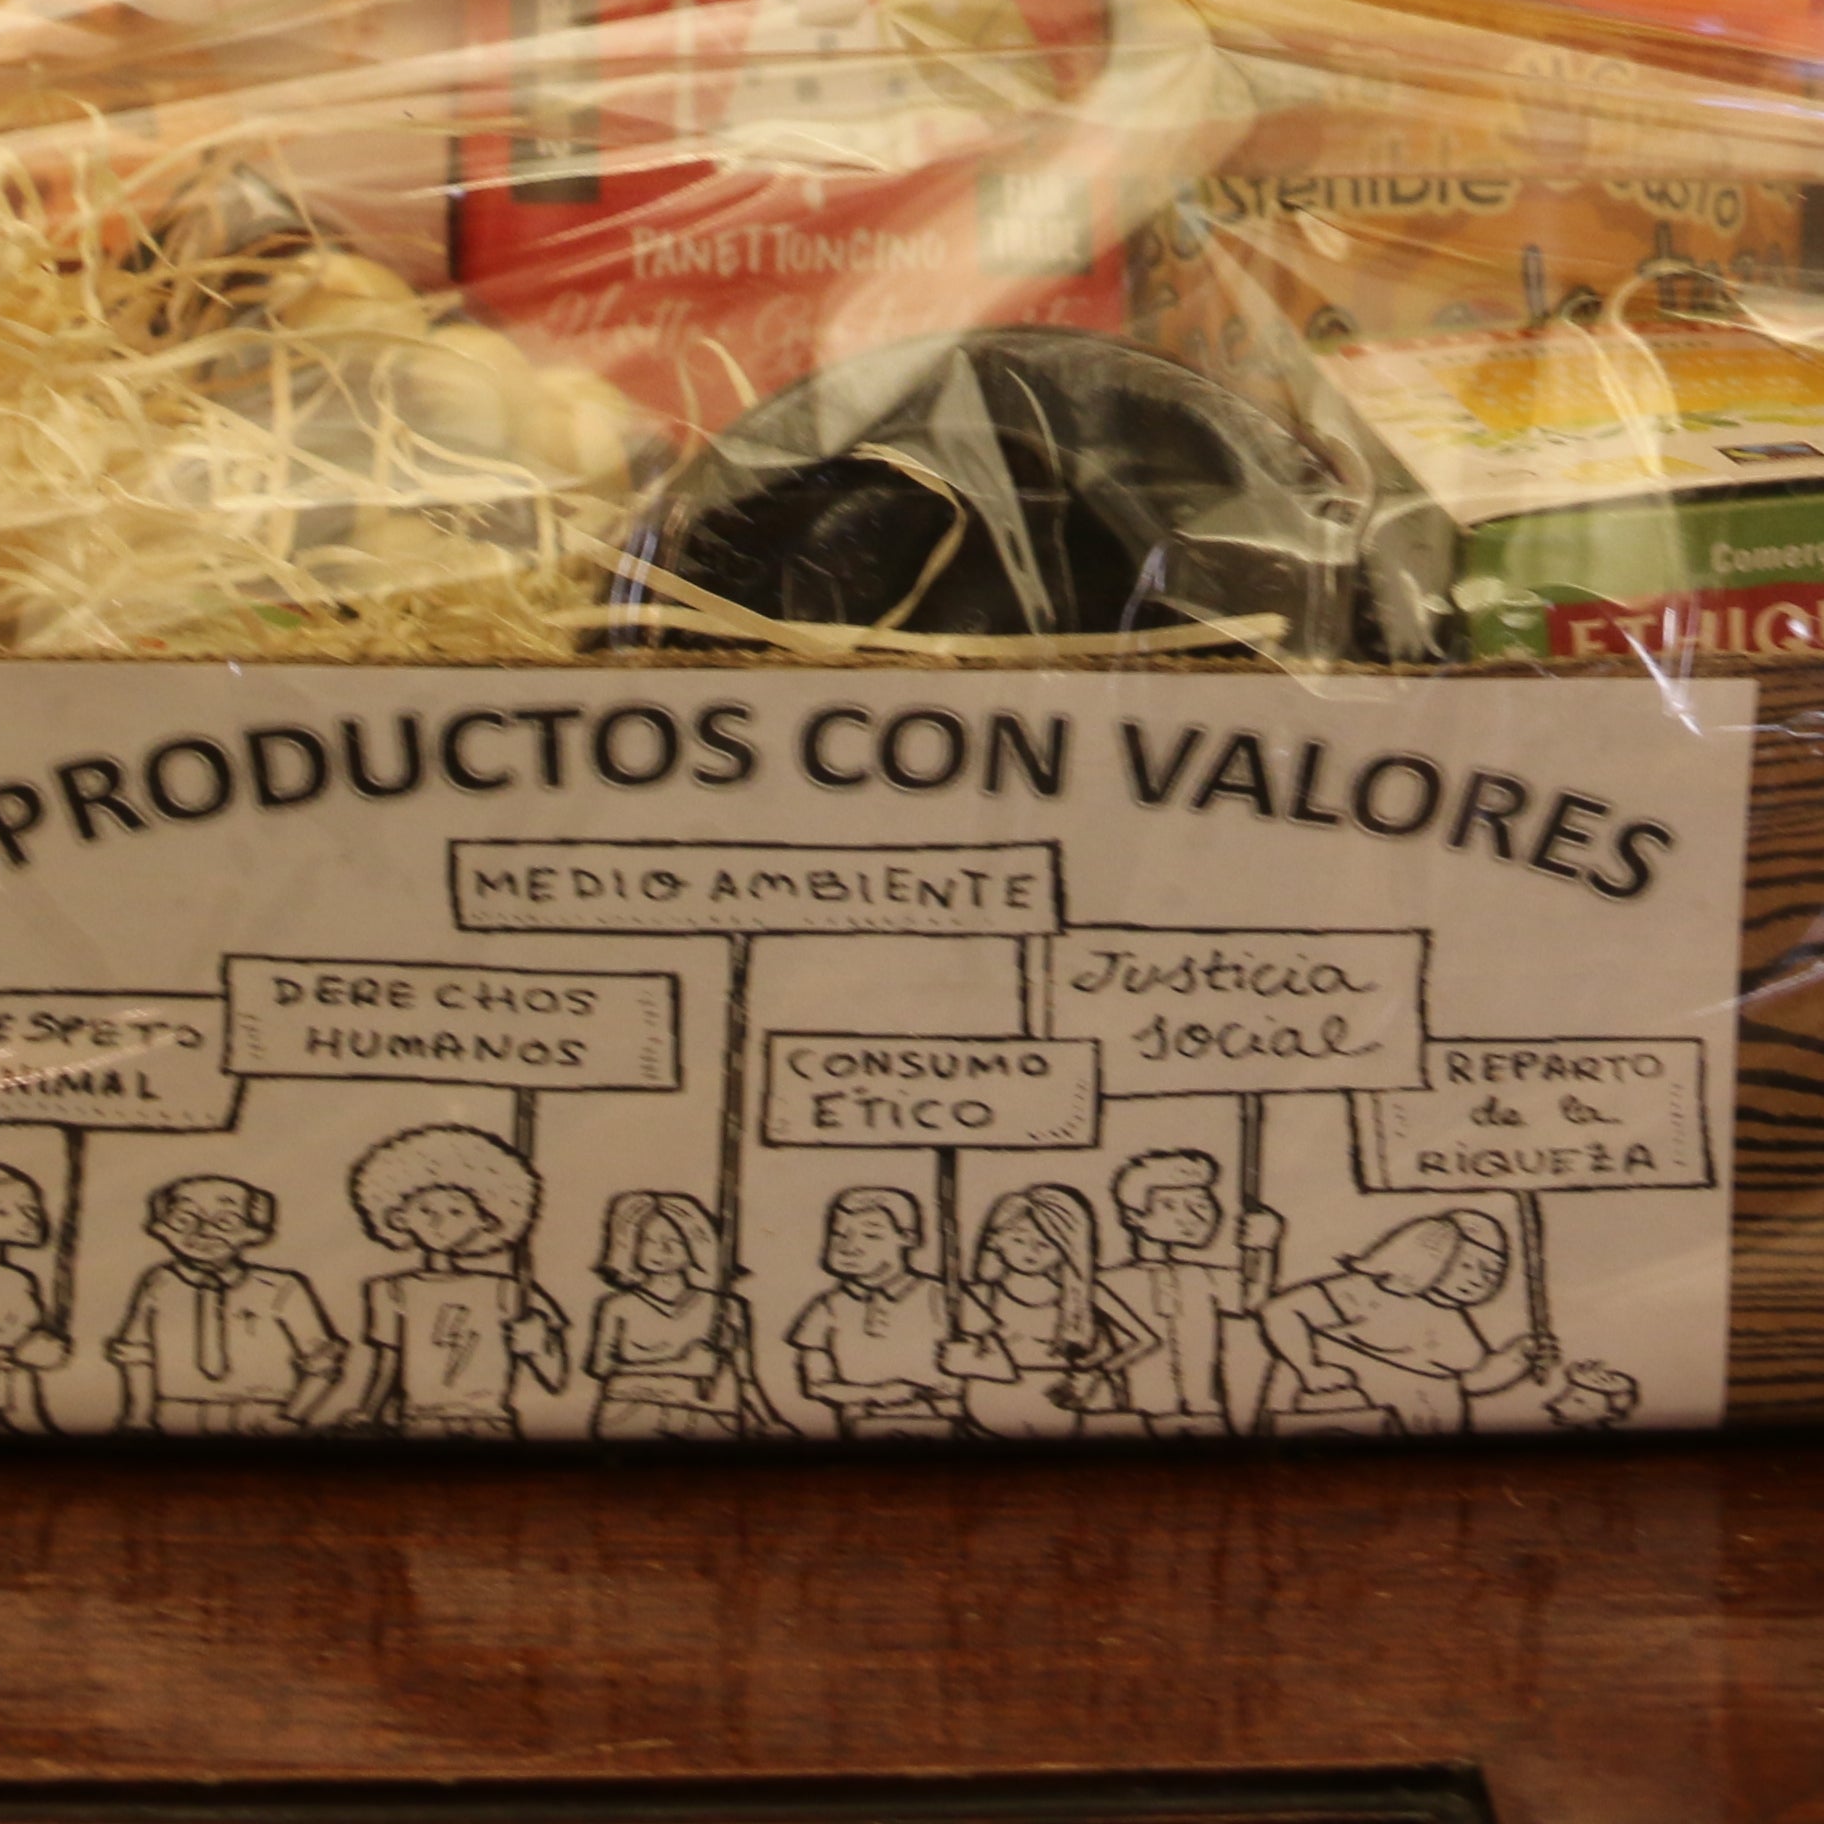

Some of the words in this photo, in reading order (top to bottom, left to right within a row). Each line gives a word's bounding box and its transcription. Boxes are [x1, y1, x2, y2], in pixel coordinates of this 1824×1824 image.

[800, 704, 1069, 798] CON
[1119, 718, 1674, 903] VALORES
[473, 864, 684, 904] MEDIO
[708, 866, 1036, 912] AMBIENTE
[1071, 948, 1378, 998] Justicia
[272, 975, 600, 1018] DERECHOS
[306, 1026, 590, 1069] HUMANOS
[1130, 1012, 1384, 1062] social
[787, 1047, 1050, 1081] CONSUMO
[1444, 1049, 1665, 1084] REPARTO
[1417, 1140, 1659, 1177] RIQUEZA
